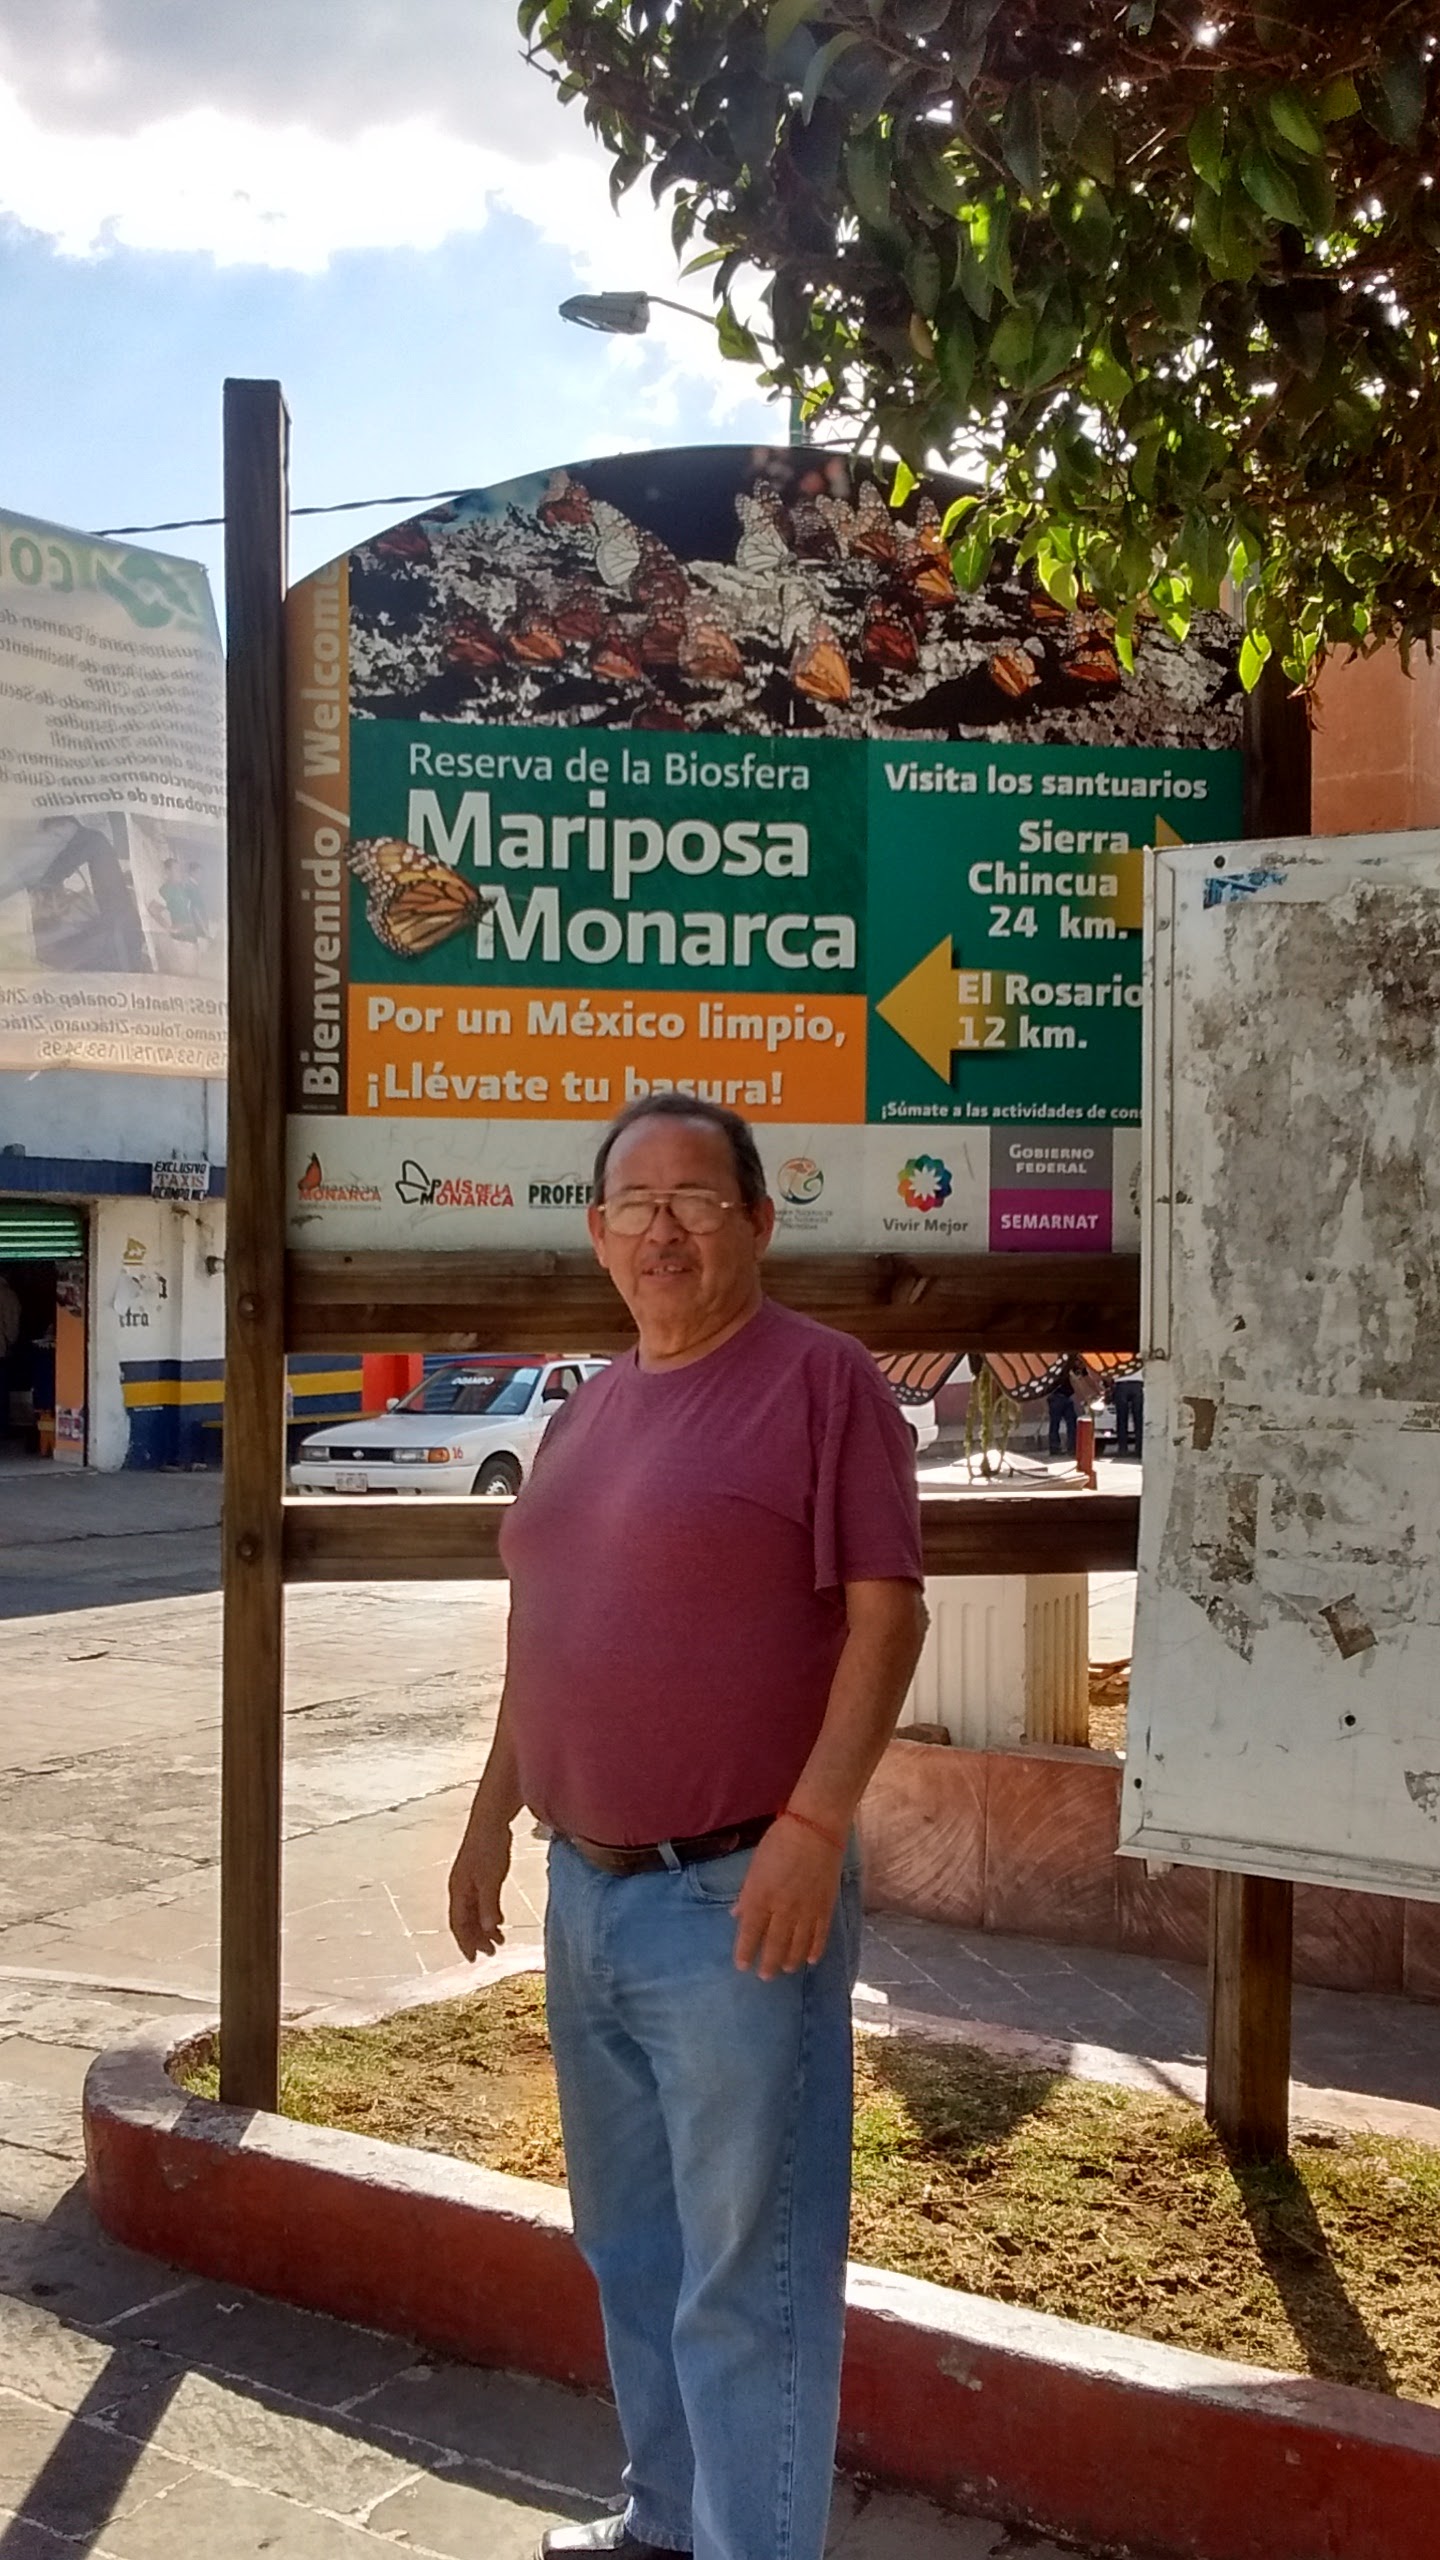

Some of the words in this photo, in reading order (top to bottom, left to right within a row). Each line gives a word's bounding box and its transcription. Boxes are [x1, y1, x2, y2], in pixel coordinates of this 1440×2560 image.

[409, 743, 553, 780] Reserva
[565, 748, 610, 784] de
[622, 749, 652, 785] la
[664, 751, 810, 791] Biosfera
[883, 762, 977, 794] Visita
[987, 764, 1033, 795] los
[1041, 770, 1208, 800] santuarios
[407, 789, 810, 900] Mariposa
[1018, 819, 1129, 854] Sierra
[968, 861, 1119, 897] Chincua
[476, 884, 857, 970] Monarca
[987, 905, 1038, 938] 24
[1059, 905, 1128, 940] km.
[957, 972, 992, 1005] El
[1005, 973, 1144, 1008] Rosario
[367, 996, 443, 1034] Por
[456, 1006, 511, 1037] un
[526, 1000, 685, 1039] México
[699, 1002, 848, 1053] limpio,
[957, 1015, 1006, 1048] 12
[1018, 1015, 1088, 1049] km.
[367, 1062, 550, 1109] ¡Llévate
[561, 1071, 610, 1103] tu
[881, 1101, 948, 1120] ¡Súmate
[953, 1106, 962, 1117] a
[966, 1102, 988, 1118] las
[992, 1102, 1083, 1119] actividades
[1087, 1104, 1106, 1119] de
[156, 1174, 205, 1188] TAXIS
[1015, 1162, 1087, 1174] FEDERAL
[420, 1192, 514, 1207] MONARCA
[883, 1218, 920, 1232] Vivir
[923, 1218, 969, 1236] Mejor
[1001, 1214, 1099, 1230] SEMARNAT
